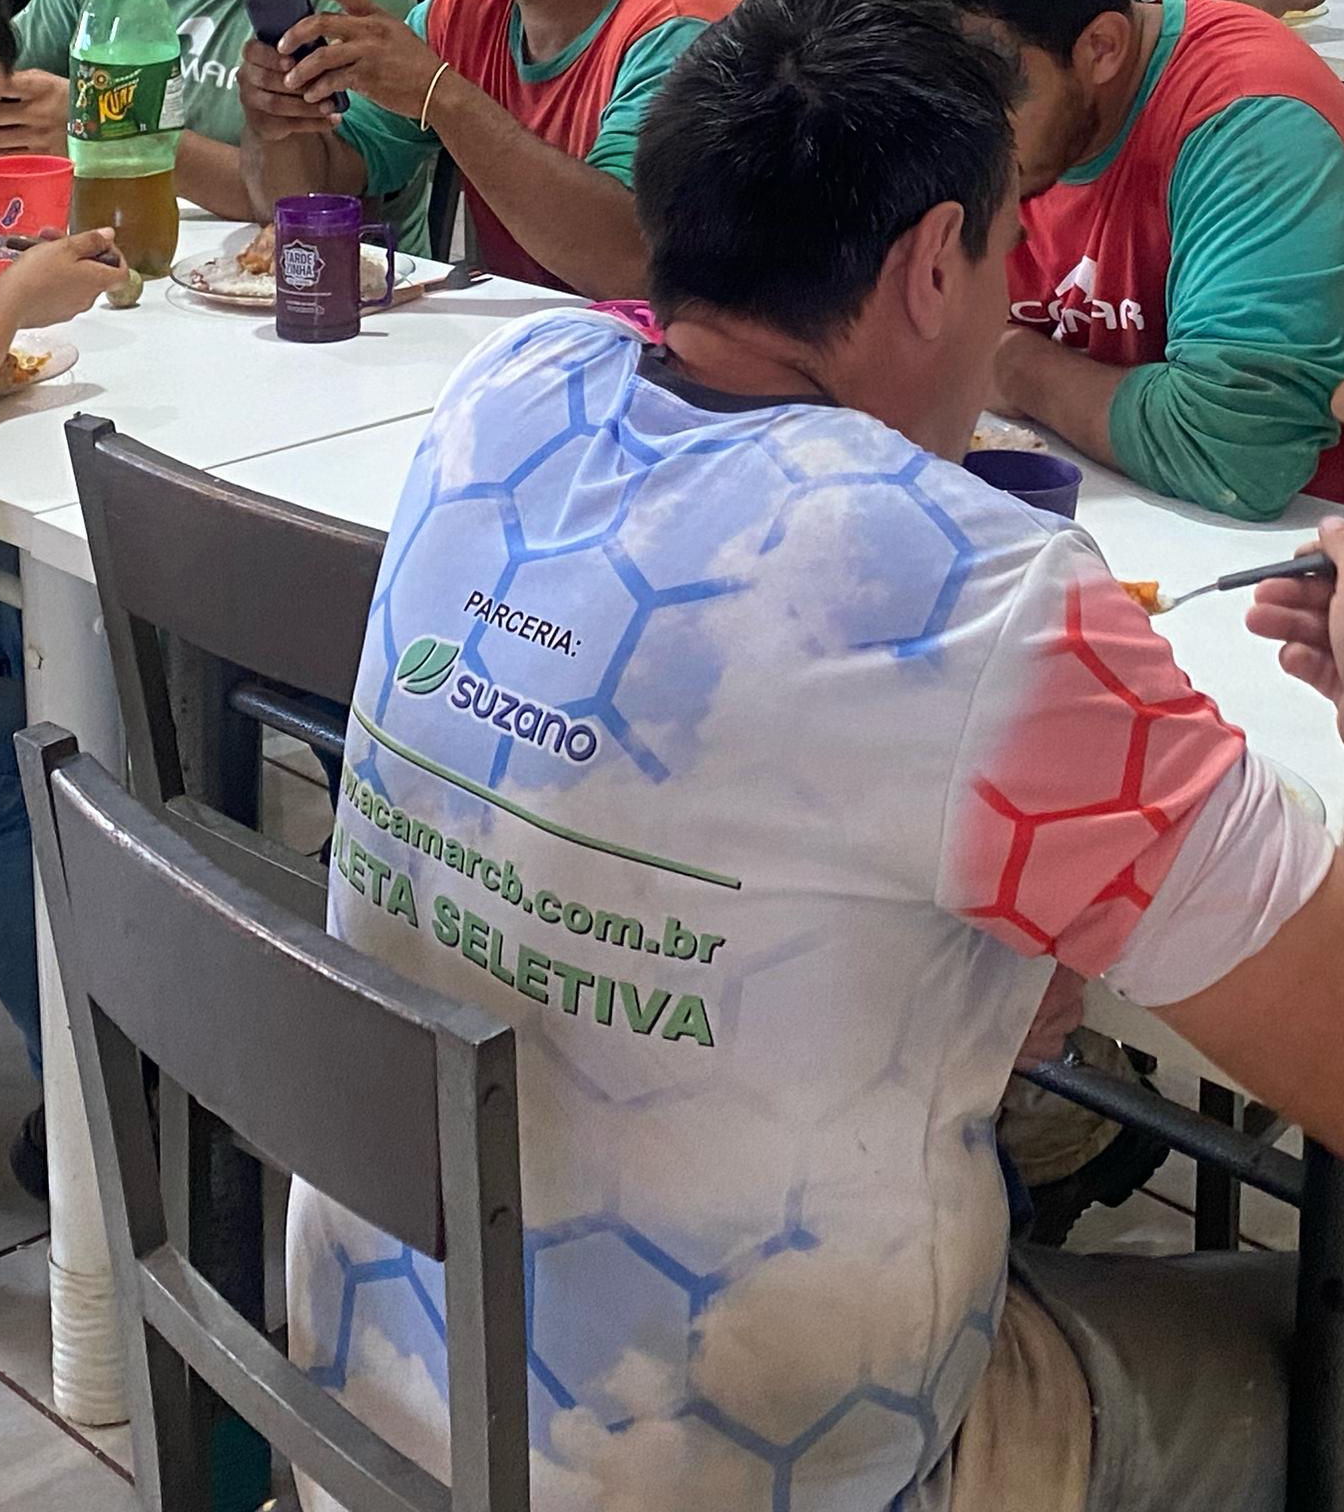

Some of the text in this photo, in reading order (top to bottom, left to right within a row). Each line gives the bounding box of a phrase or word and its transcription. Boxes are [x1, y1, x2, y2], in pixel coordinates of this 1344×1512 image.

[286, 251, 313, 265] TARDE
[286, 263, 313, 276] ZINHA
[463, 590, 583, 658] PARCERIA:
[451, 674, 599, 762] suzano
[432, 894, 714, 1047] SELETIVA
